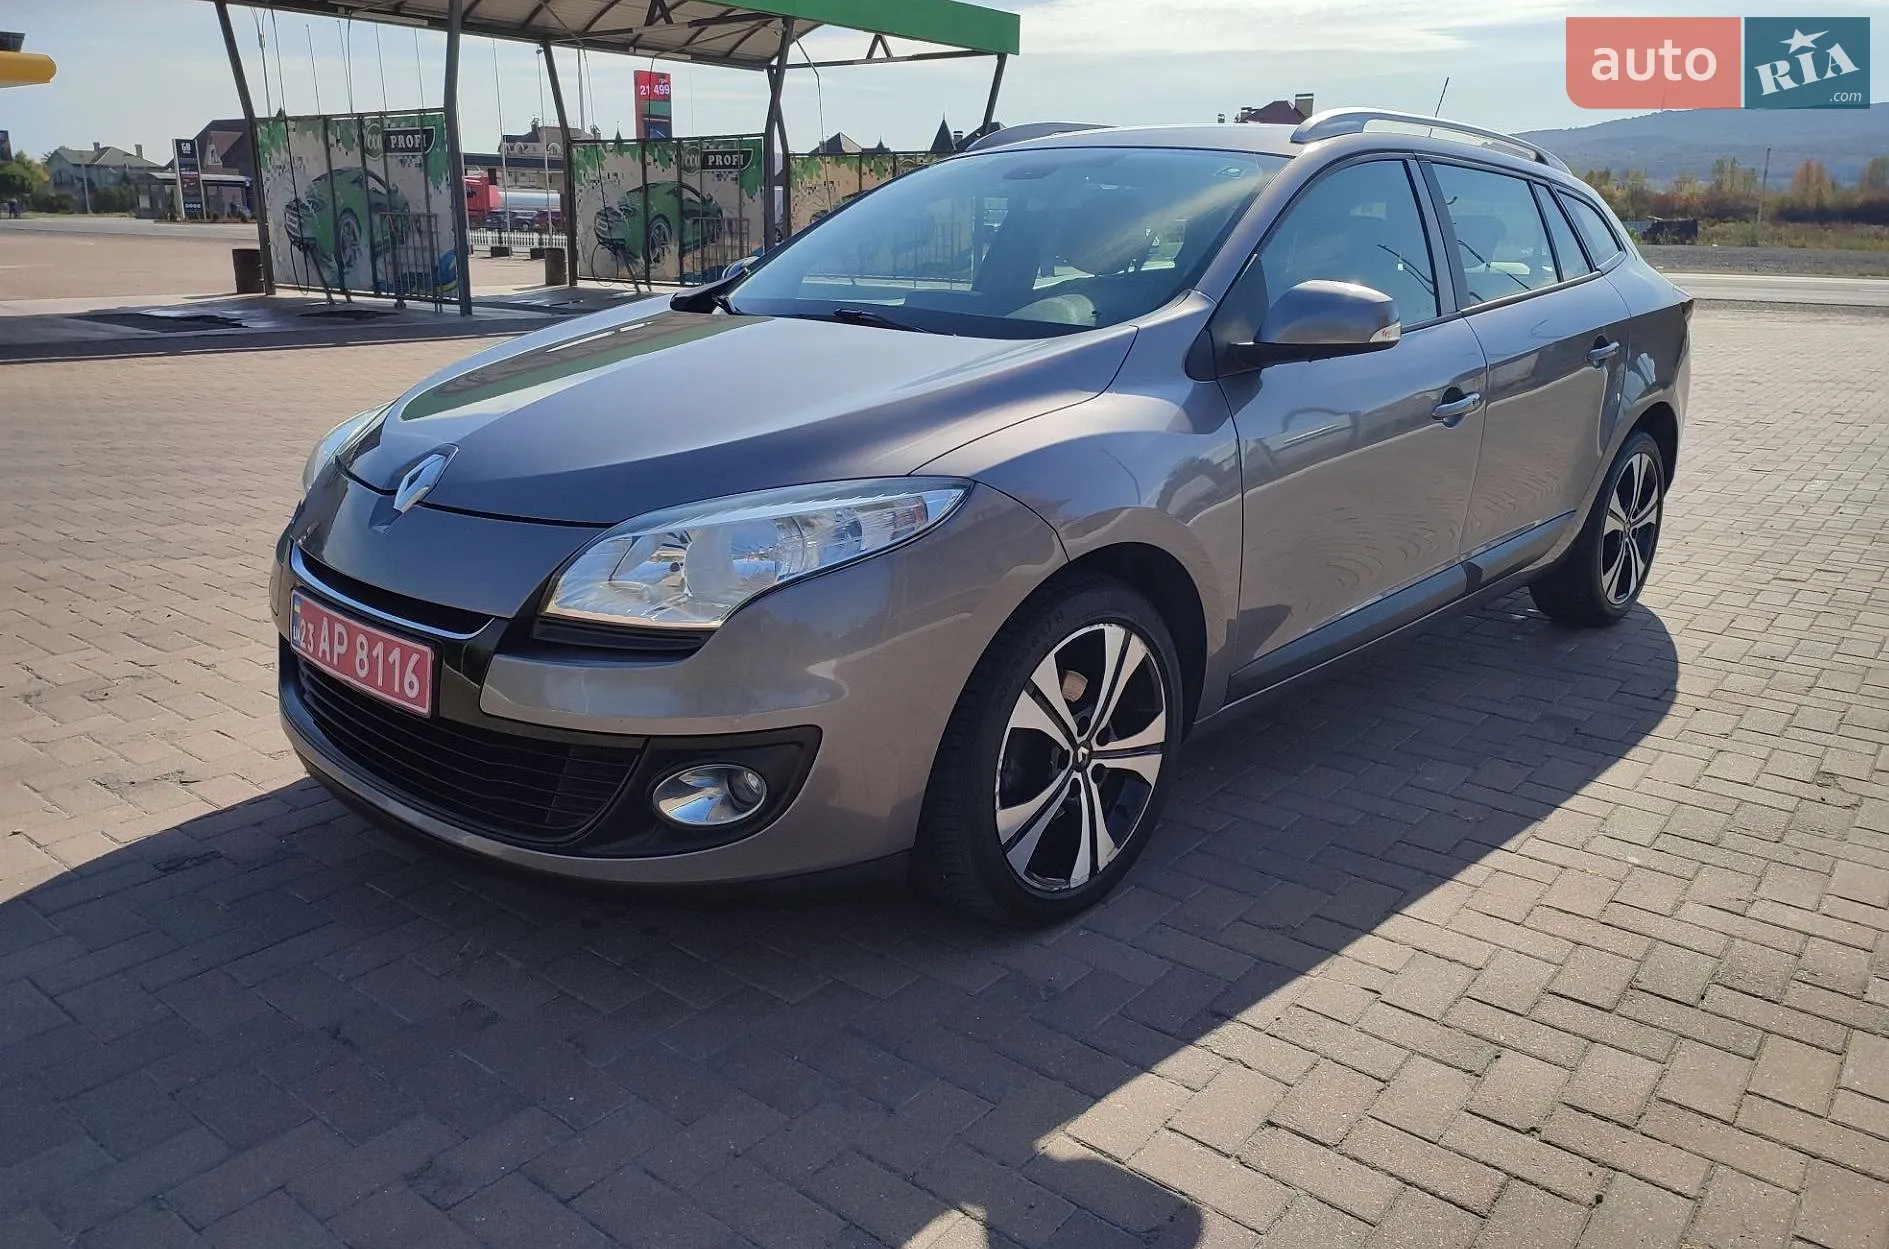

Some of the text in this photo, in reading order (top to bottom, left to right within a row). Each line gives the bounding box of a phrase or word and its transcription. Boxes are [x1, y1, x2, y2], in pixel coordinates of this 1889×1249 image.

[390, 134, 428, 149] PROFI
[707, 154, 744, 166] PROFI
[318, 616, 348, 667] AP
[355, 633, 420, 699] 8116
